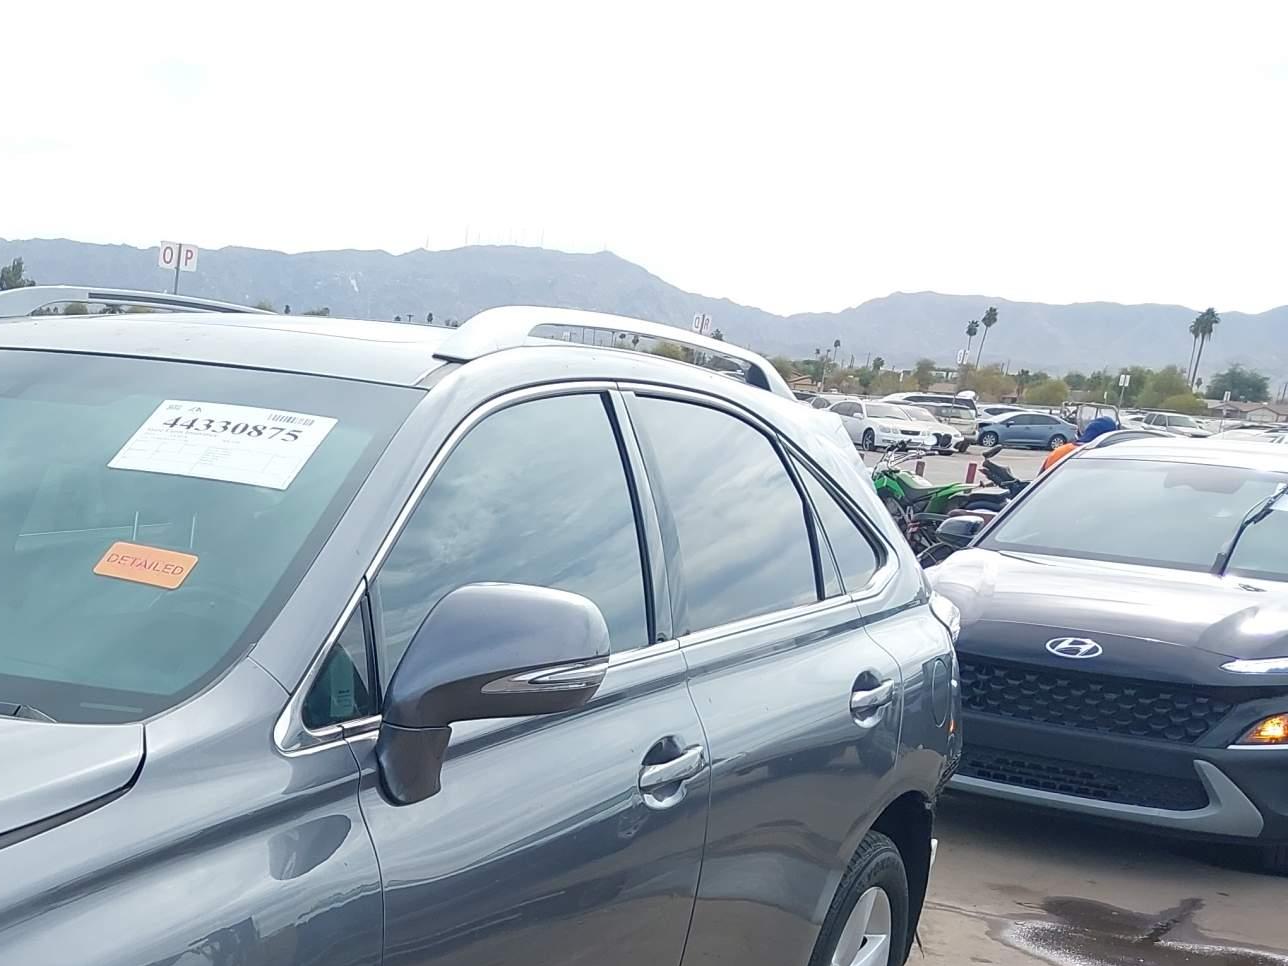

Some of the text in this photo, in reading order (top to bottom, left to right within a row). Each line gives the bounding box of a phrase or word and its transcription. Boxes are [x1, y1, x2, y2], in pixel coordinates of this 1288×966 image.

[184, 249, 194, 267] P
[163, 416, 304, 442] 44330875
[107, 553, 184, 575] DETAILED
